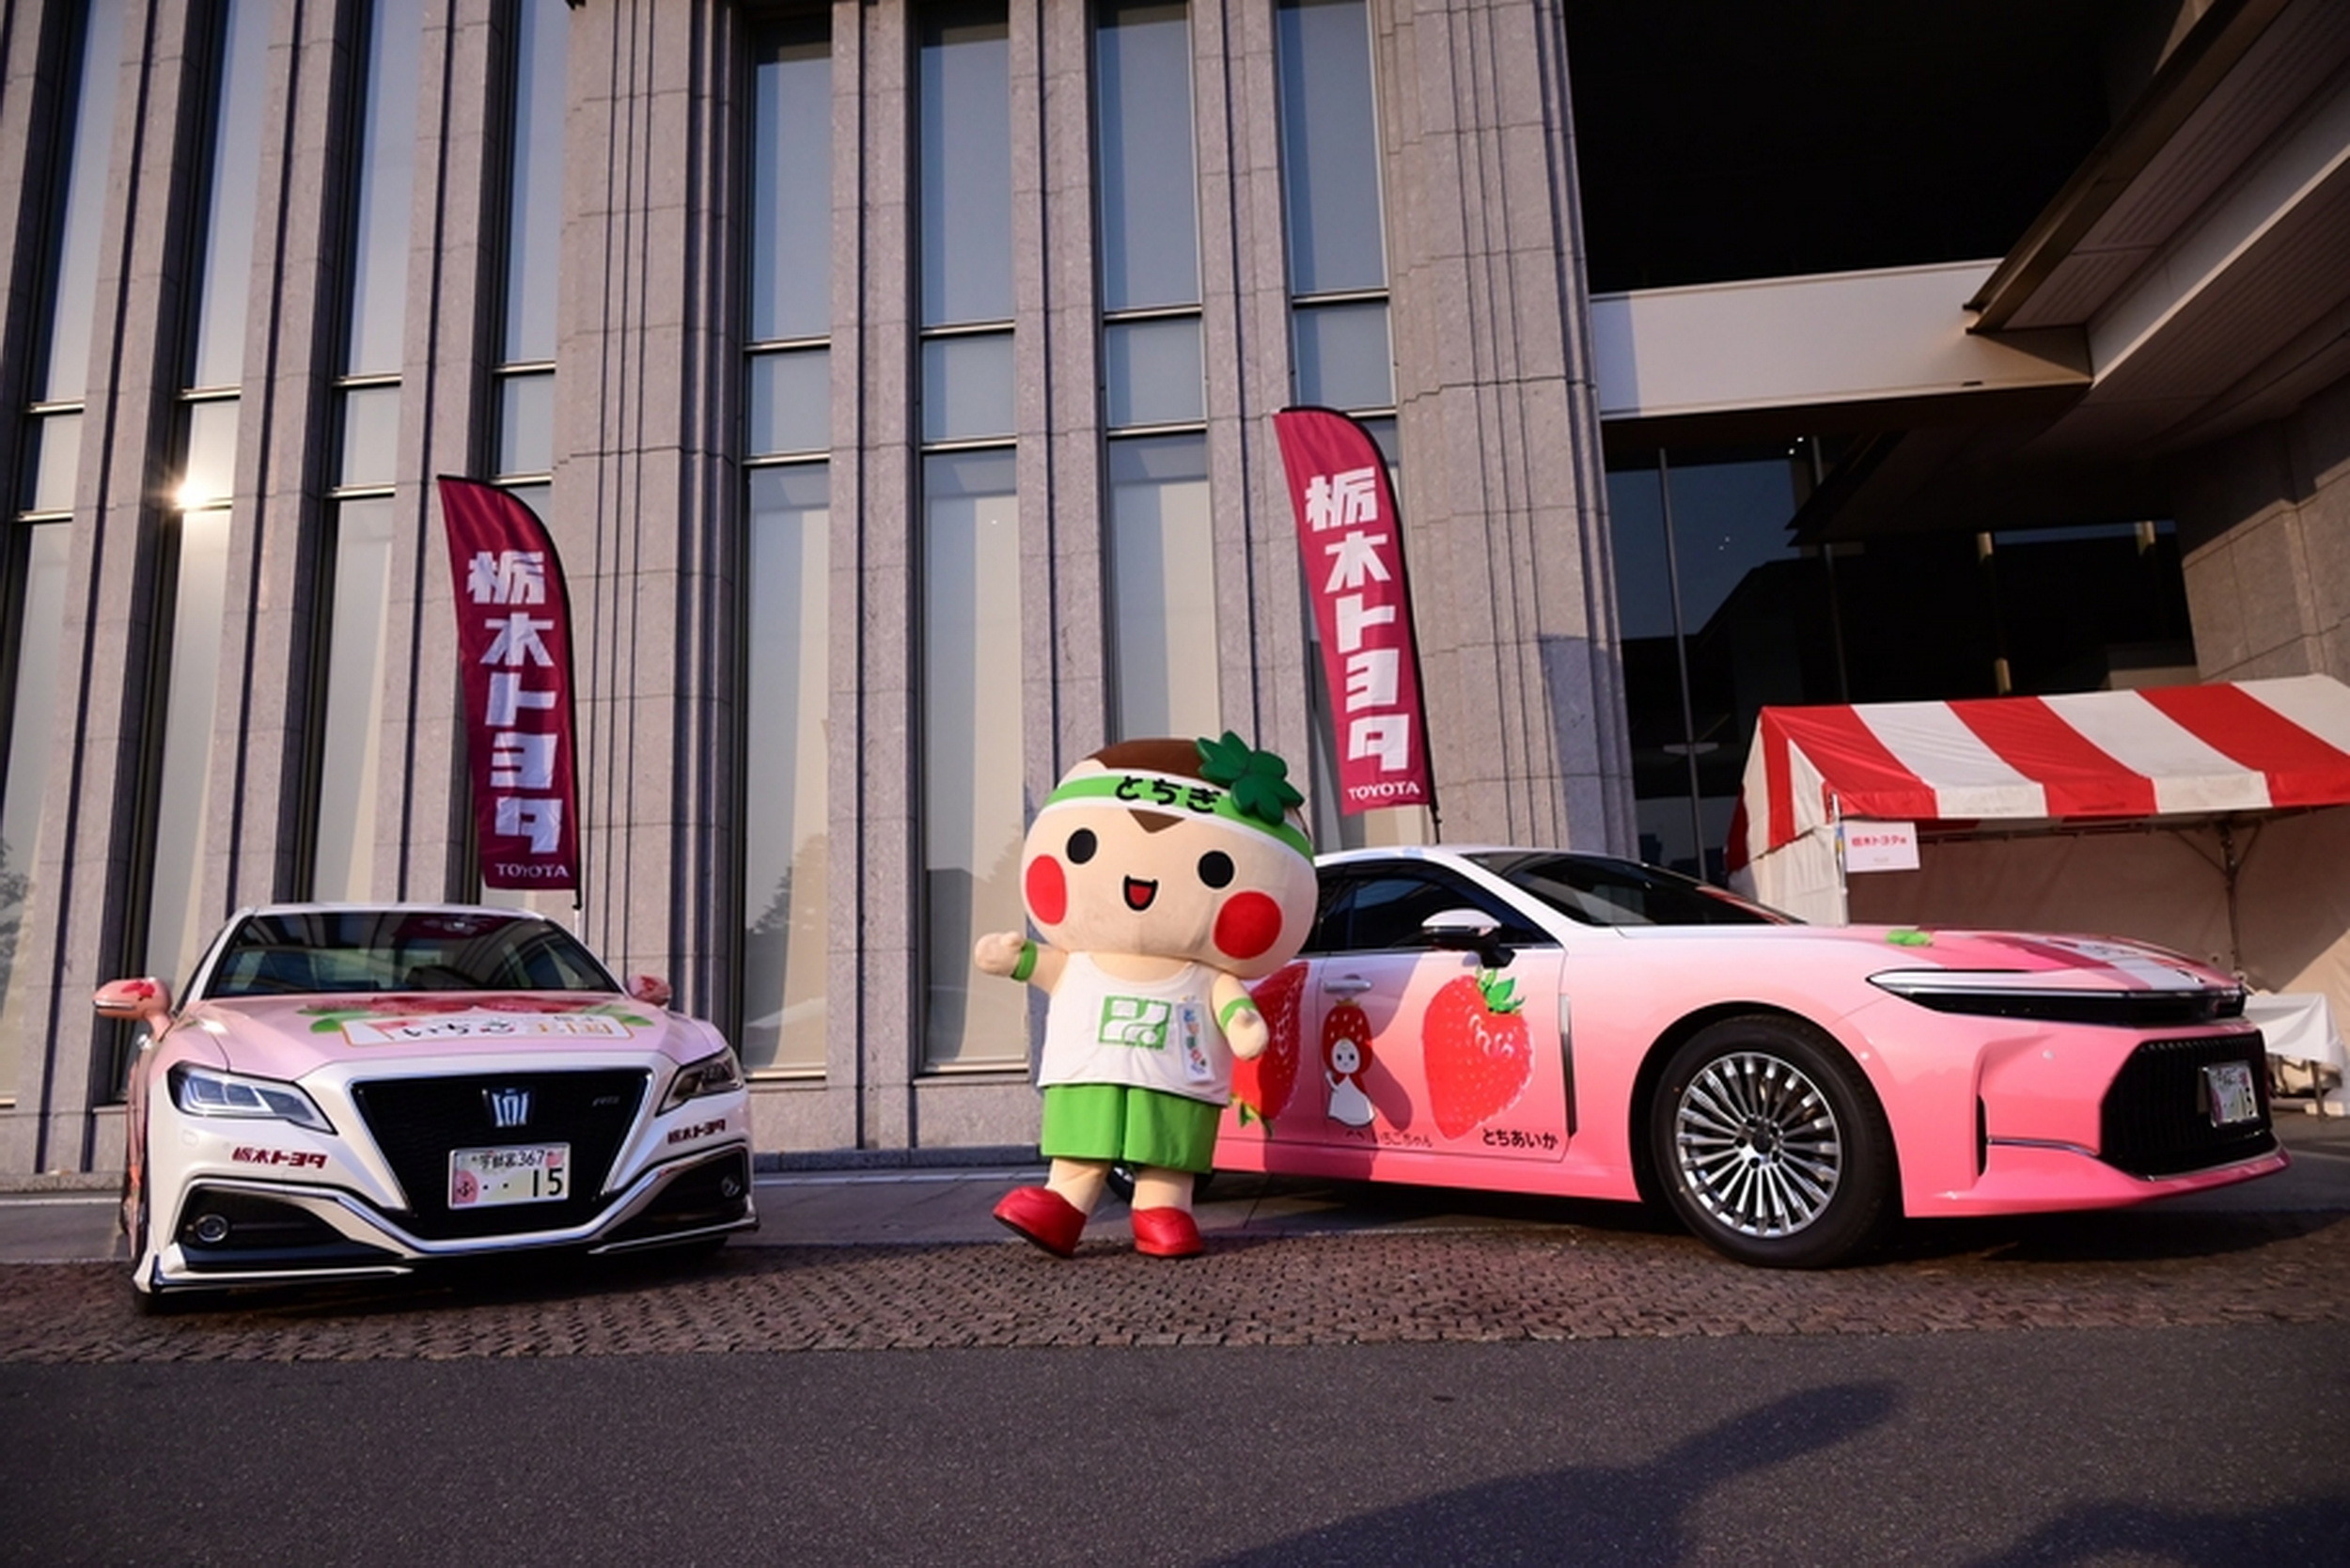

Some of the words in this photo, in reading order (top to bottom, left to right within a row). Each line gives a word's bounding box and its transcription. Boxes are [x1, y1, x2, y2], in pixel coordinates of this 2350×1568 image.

[1306, 466, 1409, 772] 栃木トヨタ
[467, 550, 563, 854] 栃木トヨタ
[1115, 775, 1222, 814] とちぎ
[1347, 781, 1420, 801] TOYOTA
[494, 863, 570, 879] TOYOTA
[1482, 1128, 1559, 1150] とちあいか
[231, 1147, 328, 1169] 栃木トヨタ
